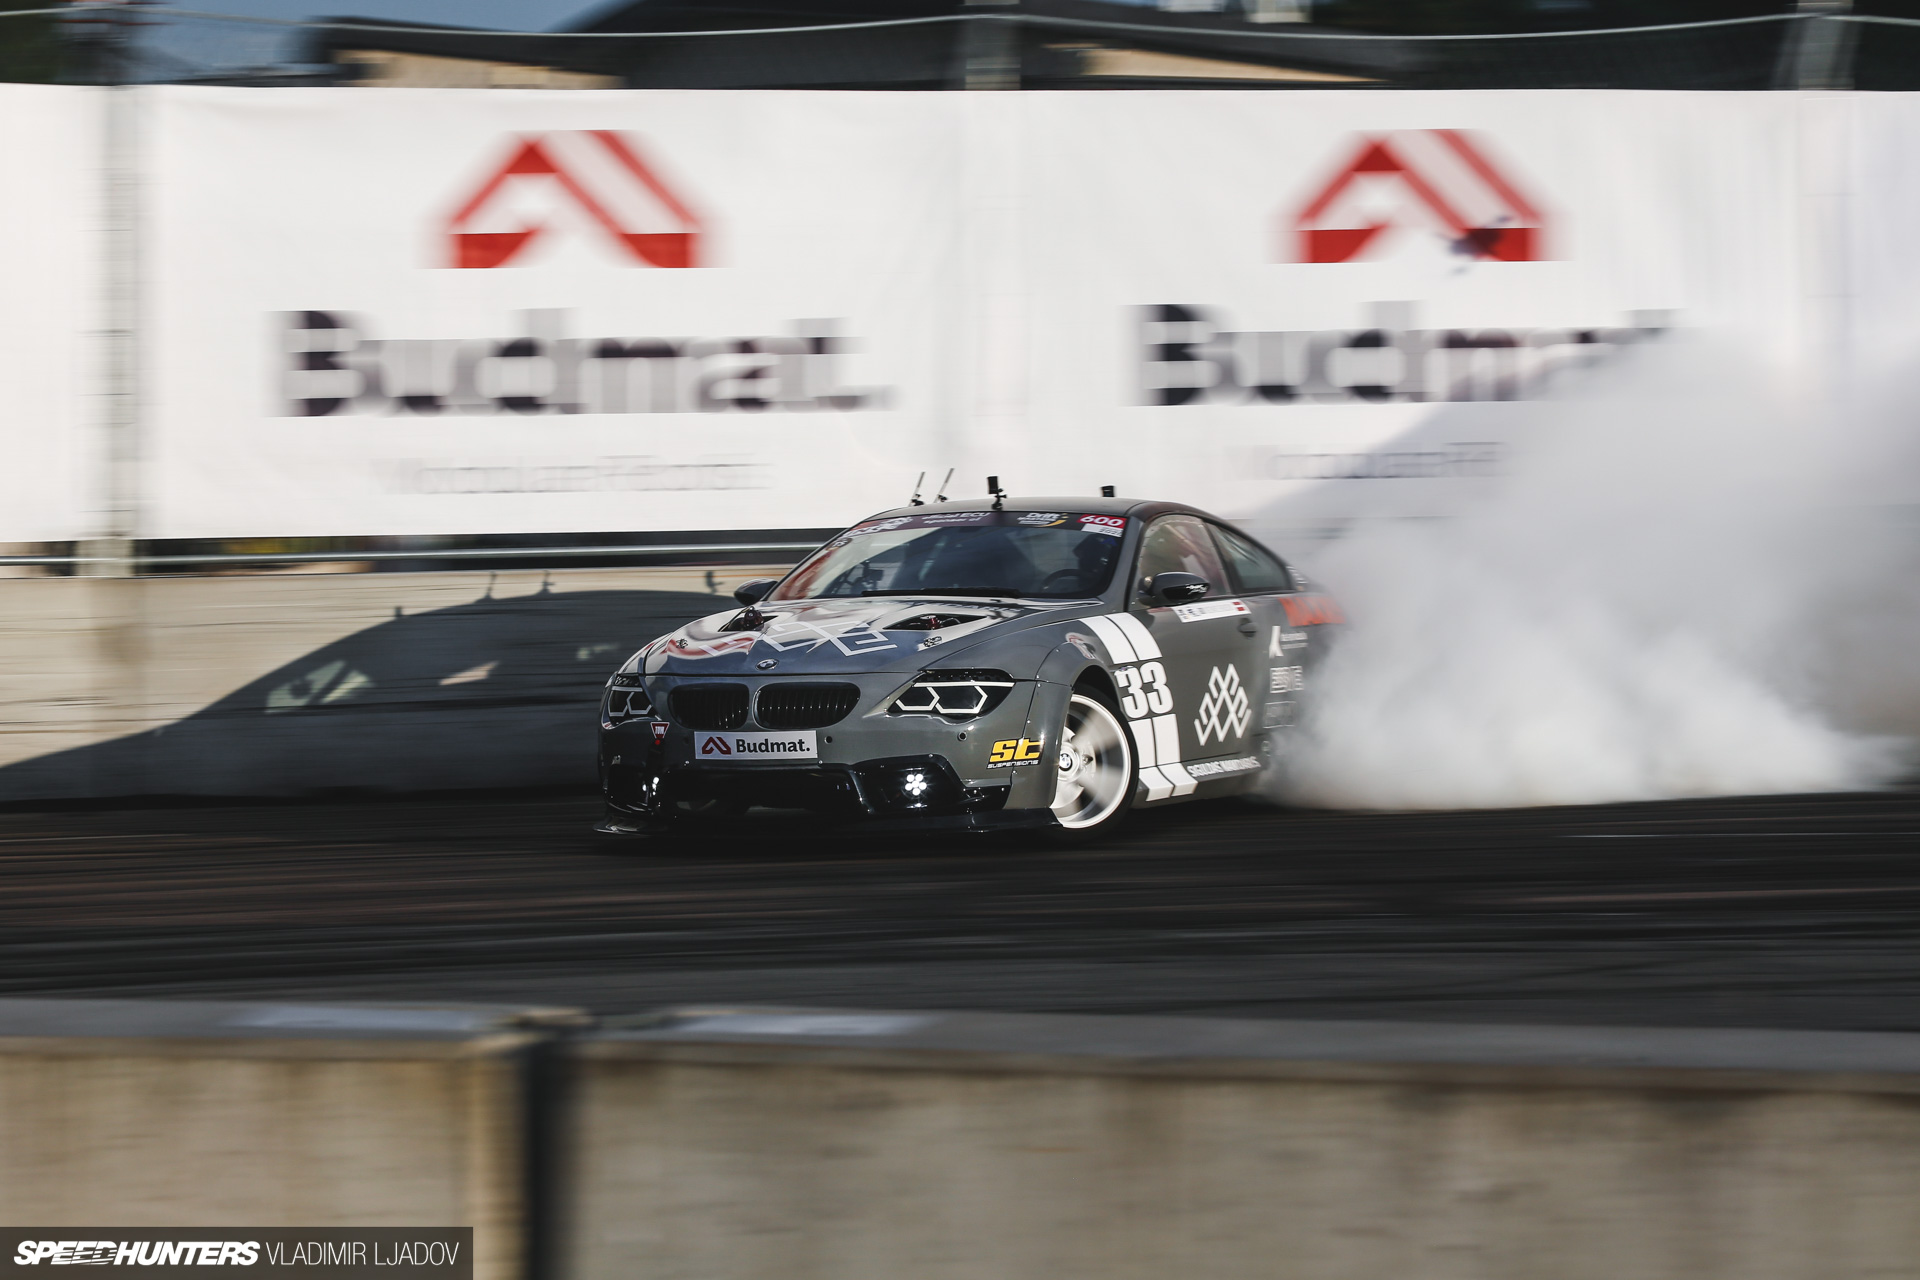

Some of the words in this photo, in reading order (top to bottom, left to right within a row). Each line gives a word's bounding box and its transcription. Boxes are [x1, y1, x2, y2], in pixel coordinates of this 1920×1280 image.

[1080, 515, 1123, 526] 600
[1114, 661, 1174, 718] 33
[735, 738, 811, 753] Budmat.
[987, 760, 1039, 769] SUSPENSIONS
